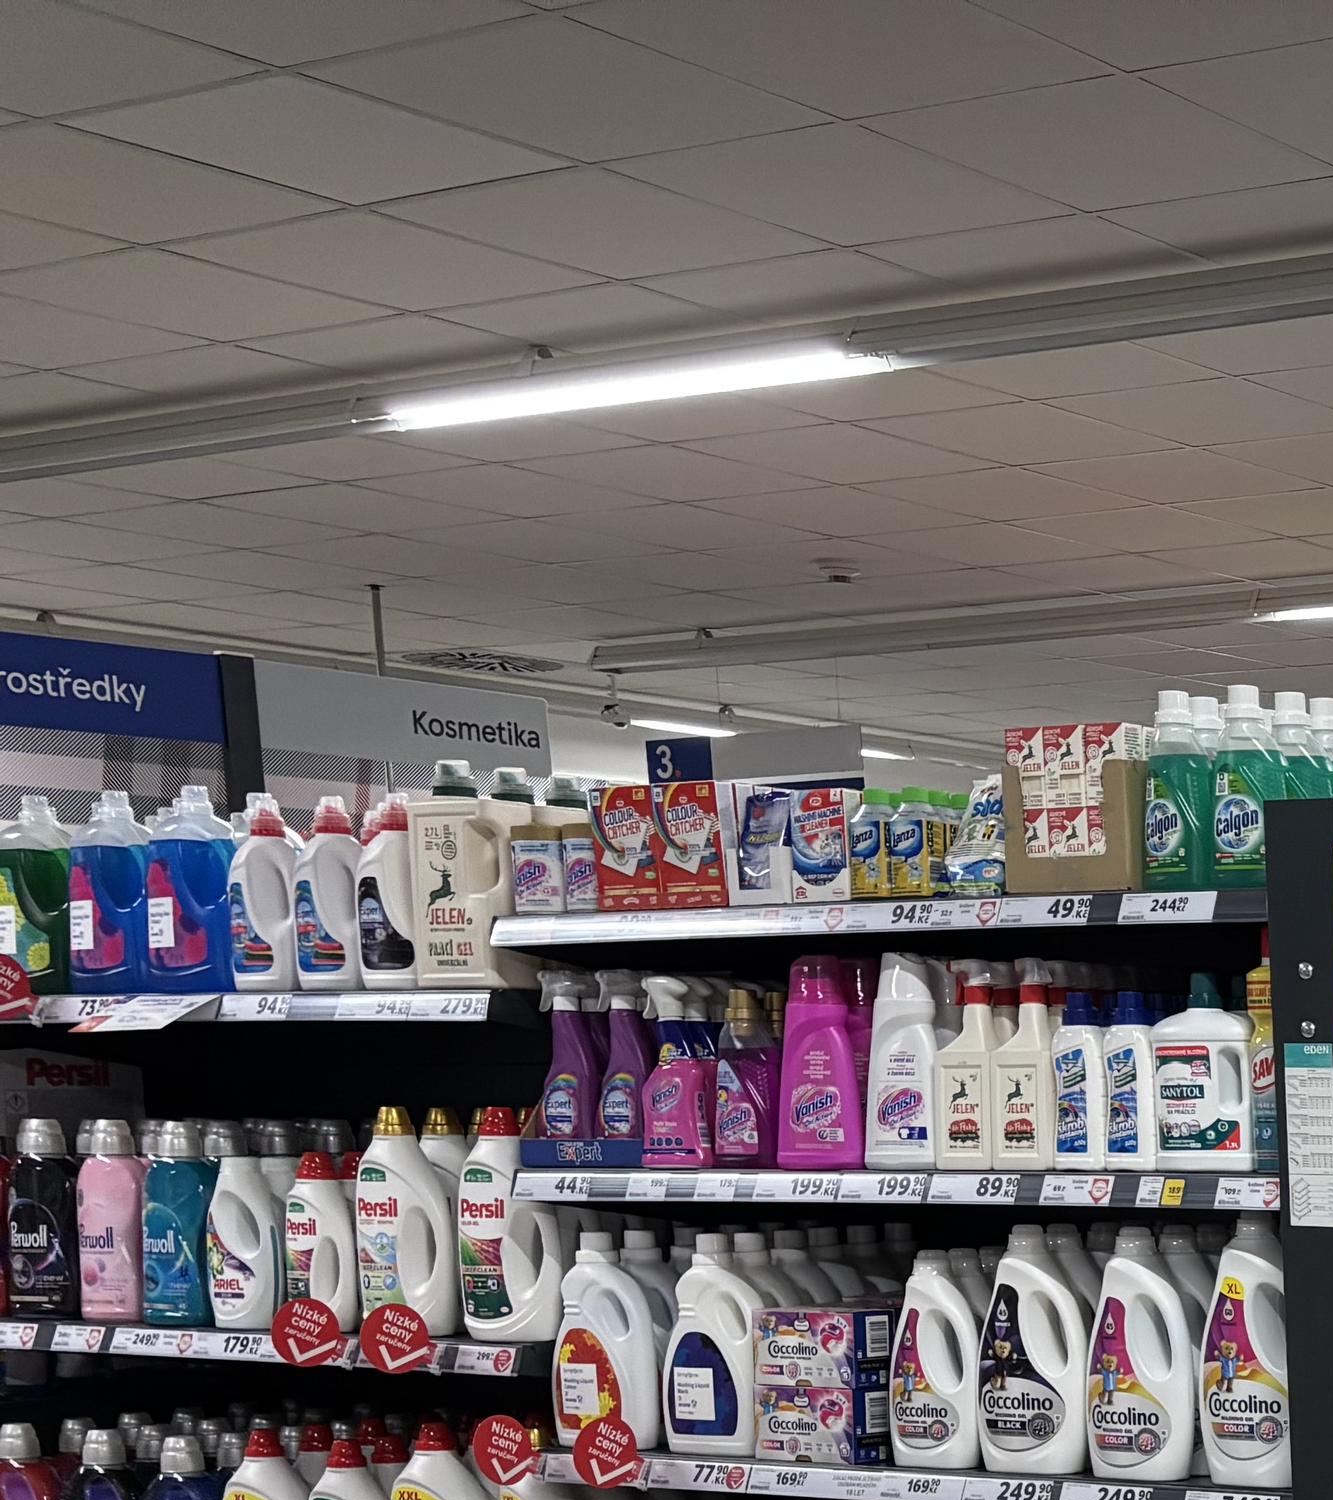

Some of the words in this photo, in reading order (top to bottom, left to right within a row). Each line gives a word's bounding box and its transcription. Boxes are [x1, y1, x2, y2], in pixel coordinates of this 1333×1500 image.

[412, 709, 541, 750] Kosmetika
[603, 809, 635, 828] COLOUR
[817, 807, 843, 820] MACHINE
[606, 822, 642, 839] CATCHER
[1145, 812, 1178, 842] calgon
[892, 828, 915, 848] Lanza
[1161, 1085, 1204, 1098] SANYTOL
[794, 1093, 833, 1124] Vanish
[952, 1103, 976, 1115] JELEN
[1007, 1103, 1032, 1115] JELEN
[719, 1108, 749, 1133] Vanish
[557, 1142, 602, 1165] Expert
[357, 1197, 398, 1220] Persil
[460, 1197, 505, 1219] Persil
[287, 1218, 316, 1237] Persil
[213, 1278, 244, 1293] ARIEL
[1226, 1283, 1240, 1294] XL
[292, 1301, 328, 1325] Nízké
[383, 1308, 419, 1330] Nízké
[291, 1315, 322, 1333] ceny
[381, 1321, 414, 1342] ceny
[283, 1325, 322, 1347] zaručeny
[375, 1332, 412, 1353] zaručeny
[768, 1341, 818, 1360] Coccolino
[895, 1401, 948, 1422] Coccolino
[983, 1389, 1053, 1416] Coccolino
[768, 1416, 817, 1434] Coccolino
[998, 1421, 1022, 1430] BLACK
[1092, 1403, 1159, 1428] Coccolino
